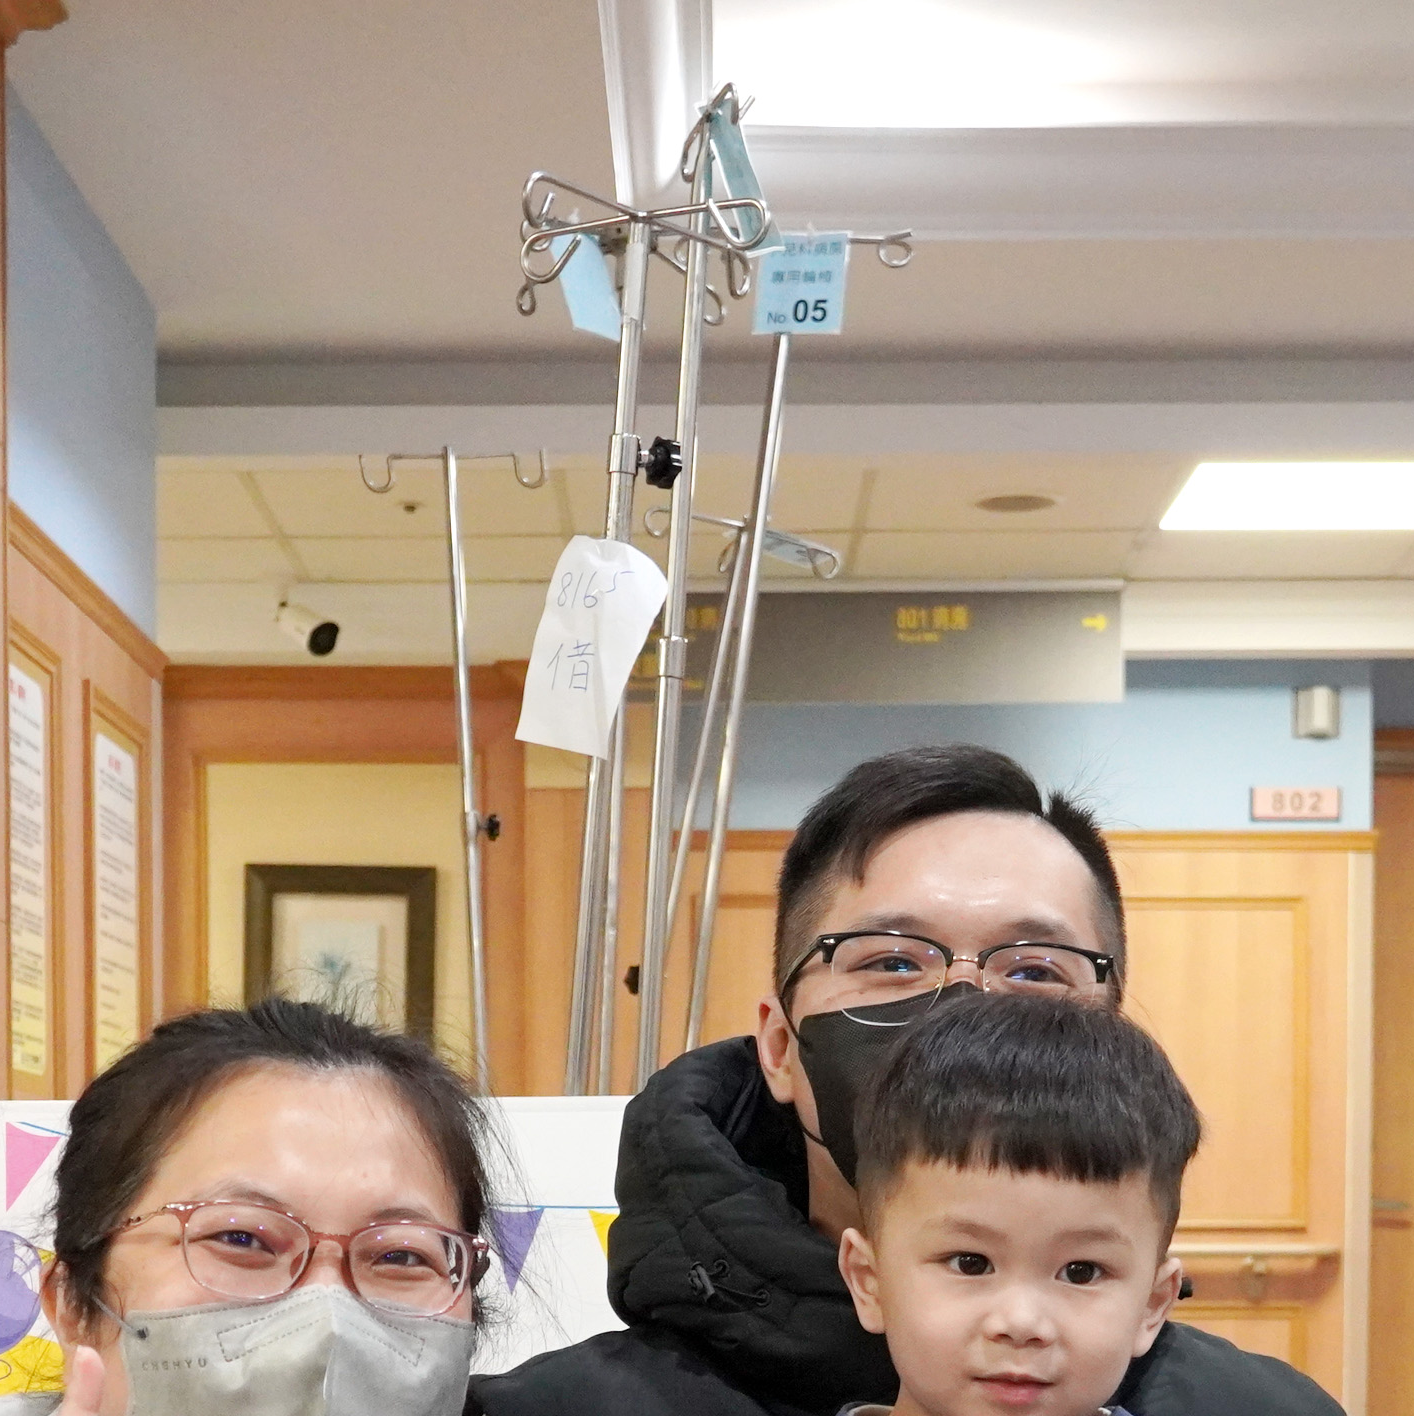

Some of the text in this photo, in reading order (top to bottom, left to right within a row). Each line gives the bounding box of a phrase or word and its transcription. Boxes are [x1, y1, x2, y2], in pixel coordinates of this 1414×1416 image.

[793, 299, 828, 323] 05
[547, 639, 595, 692] 借
[1271, 792, 1322, 811] 802
